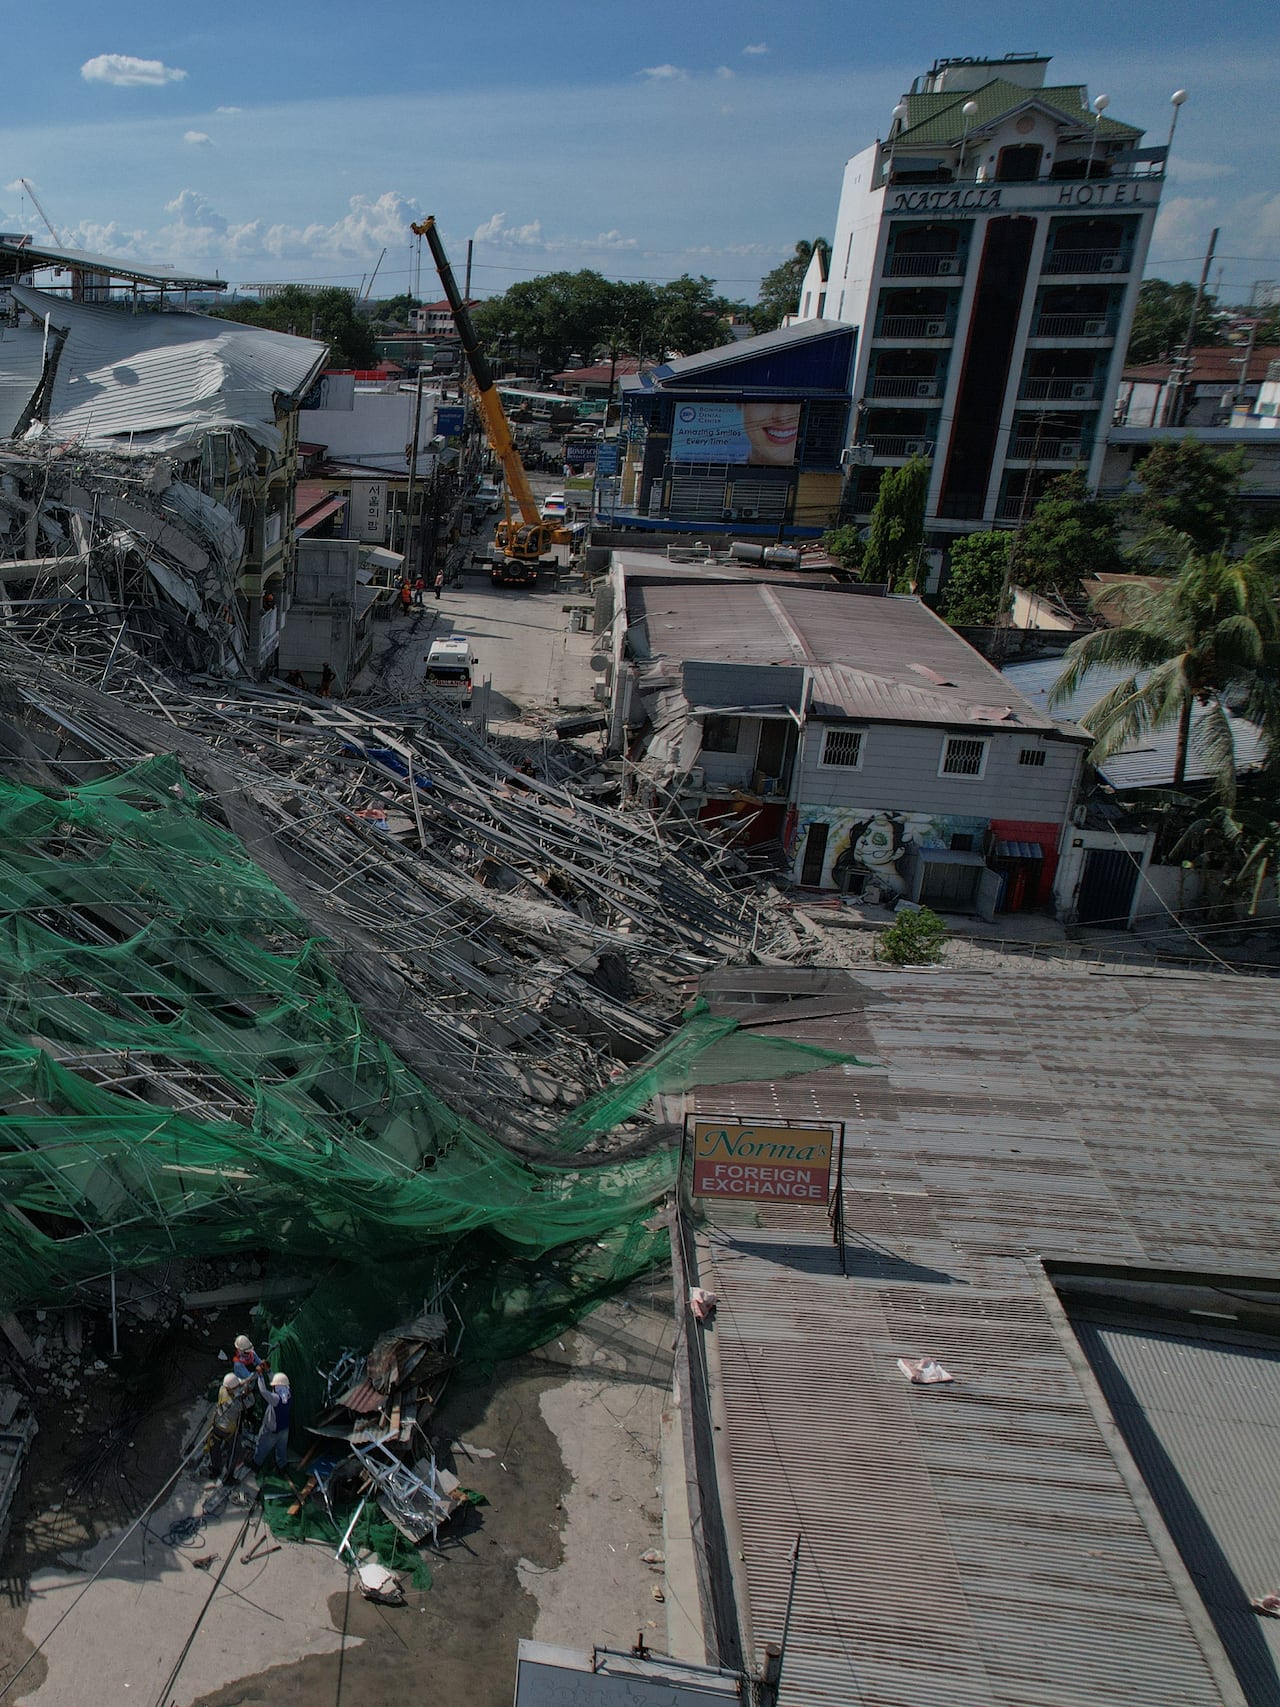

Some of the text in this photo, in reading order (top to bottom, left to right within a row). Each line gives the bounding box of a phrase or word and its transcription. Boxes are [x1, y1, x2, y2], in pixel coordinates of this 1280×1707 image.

[892, 183, 1142, 210] NATALIA HOTEL
[698, 1130, 828, 1161] Norma's
[714, 1164, 811, 1183] FOREIGN
[701, 1177, 823, 1198] EXCHANGE
